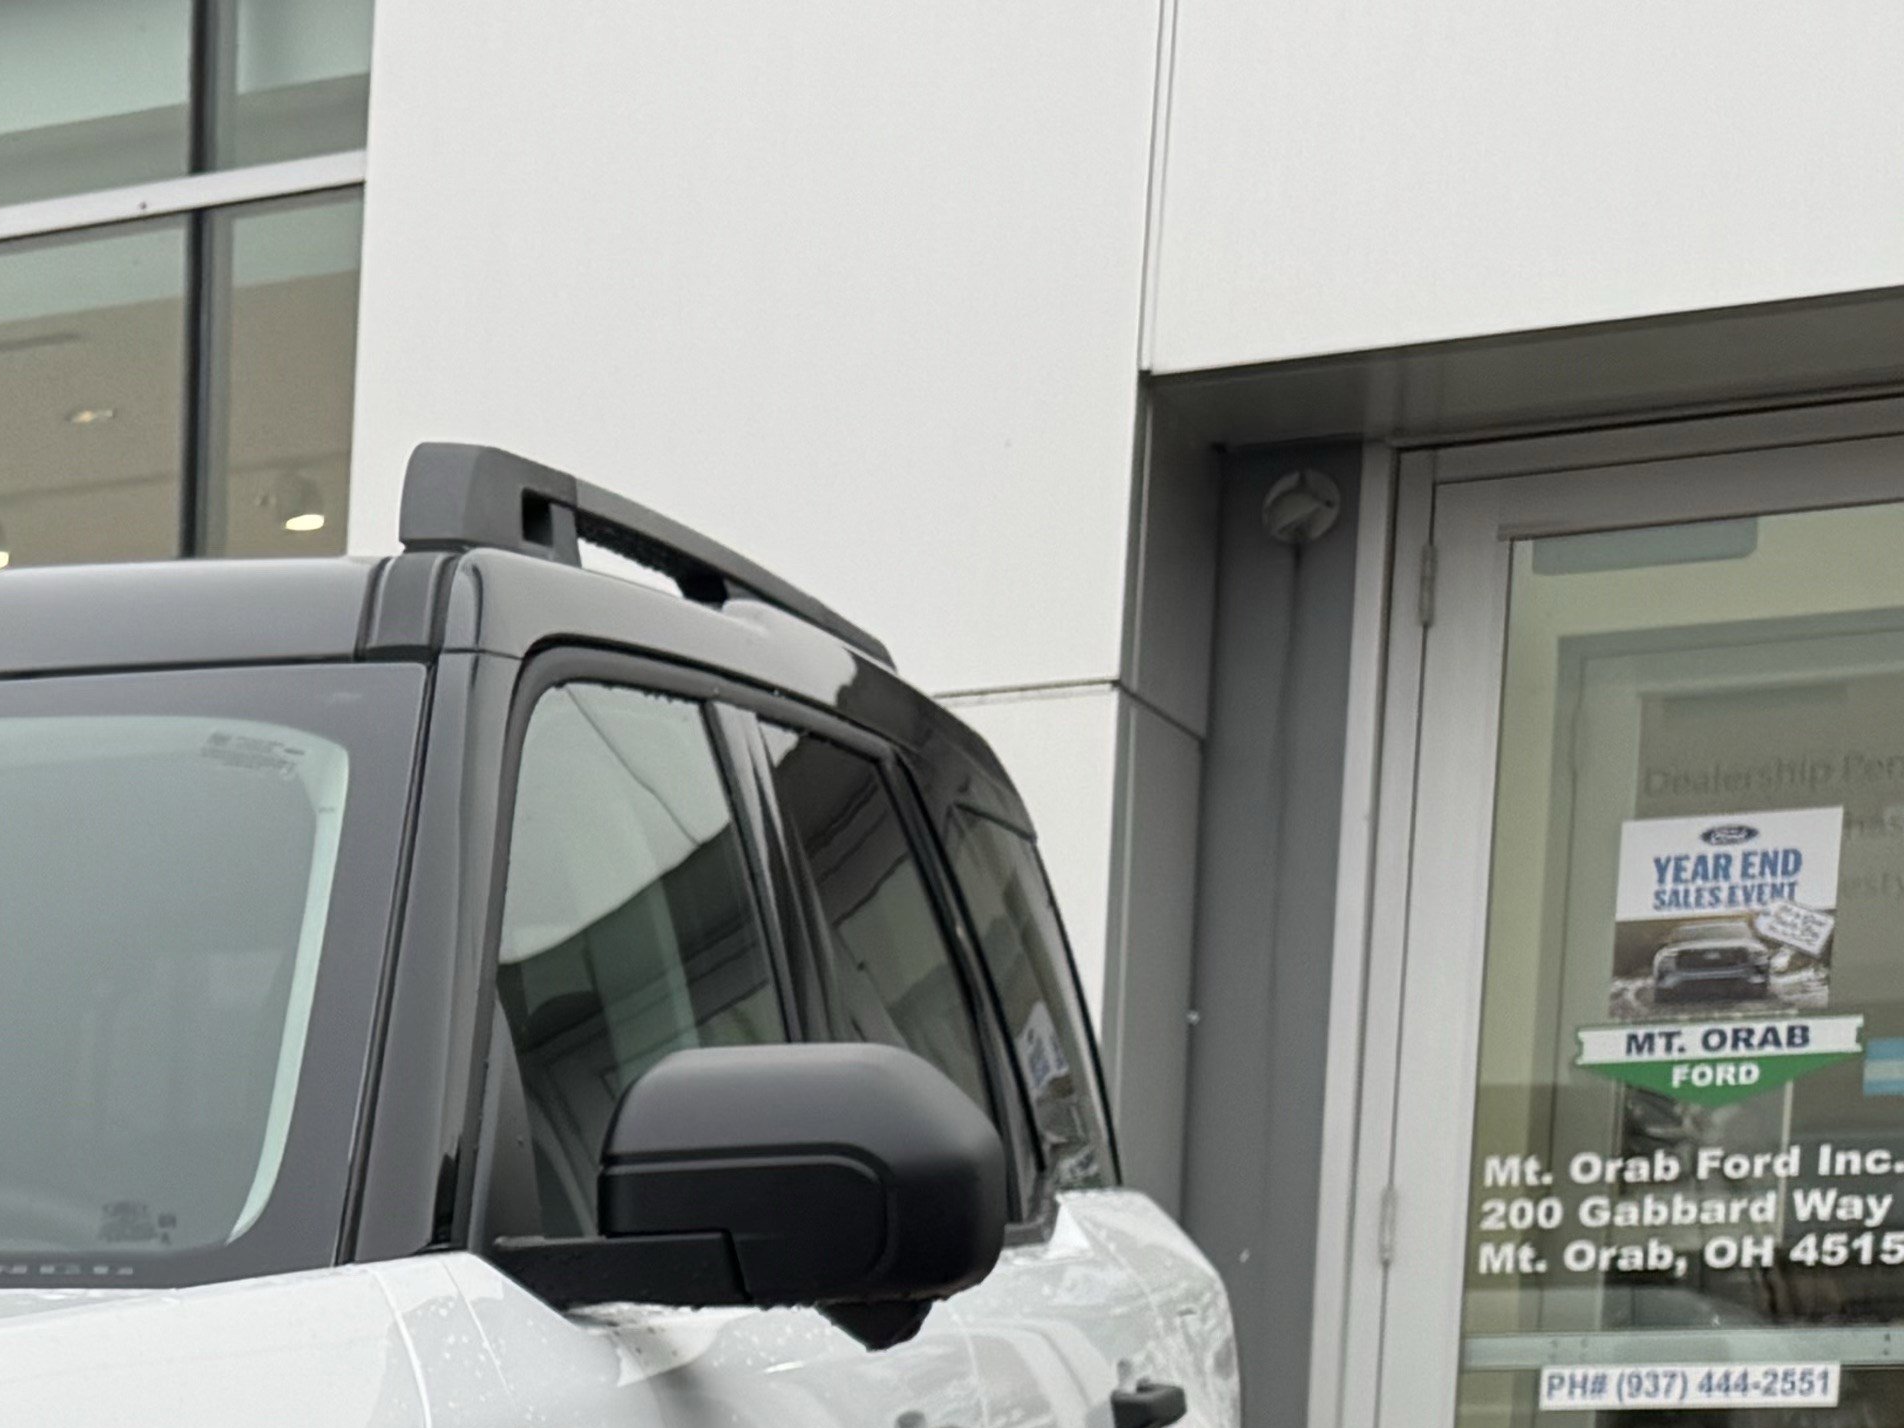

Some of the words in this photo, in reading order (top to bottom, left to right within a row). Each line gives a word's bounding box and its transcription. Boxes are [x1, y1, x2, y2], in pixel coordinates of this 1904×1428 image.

[1653, 852, 1733, 885] YEAR
[1740, 848, 1803, 879] END
[1652, 887, 1720, 911] SALES
[1727, 881, 1798, 907] EVENT
[1624, 1030, 1686, 1056] MT.
[1701, 1024, 1811, 1050] ORAB
[1671, 1063, 1761, 1089] FORD
[1483, 1154, 1554, 1187] Mt.
[1569, 1149, 1681, 1185] Orab
[1696, 1145, 1801, 1180] Ford
[1817, 1144, 1904, 1176] Inc.
[1478, 1197, 1563, 1231] 200
[1578, 1191, 1777, 1227] Gabbard
[1792, 1187, 1894, 1227] Way
[1477, 1241, 1548, 1274] Mt.
[1563, 1237, 1688, 1277] Orab,
[1703, 1235, 1775, 1268] OH
[1546, 1369, 1608, 1401] PH#
[1616, 1369, 1689, 1404] (937)
[1698, 1367, 1830, 1398] 444-2551
